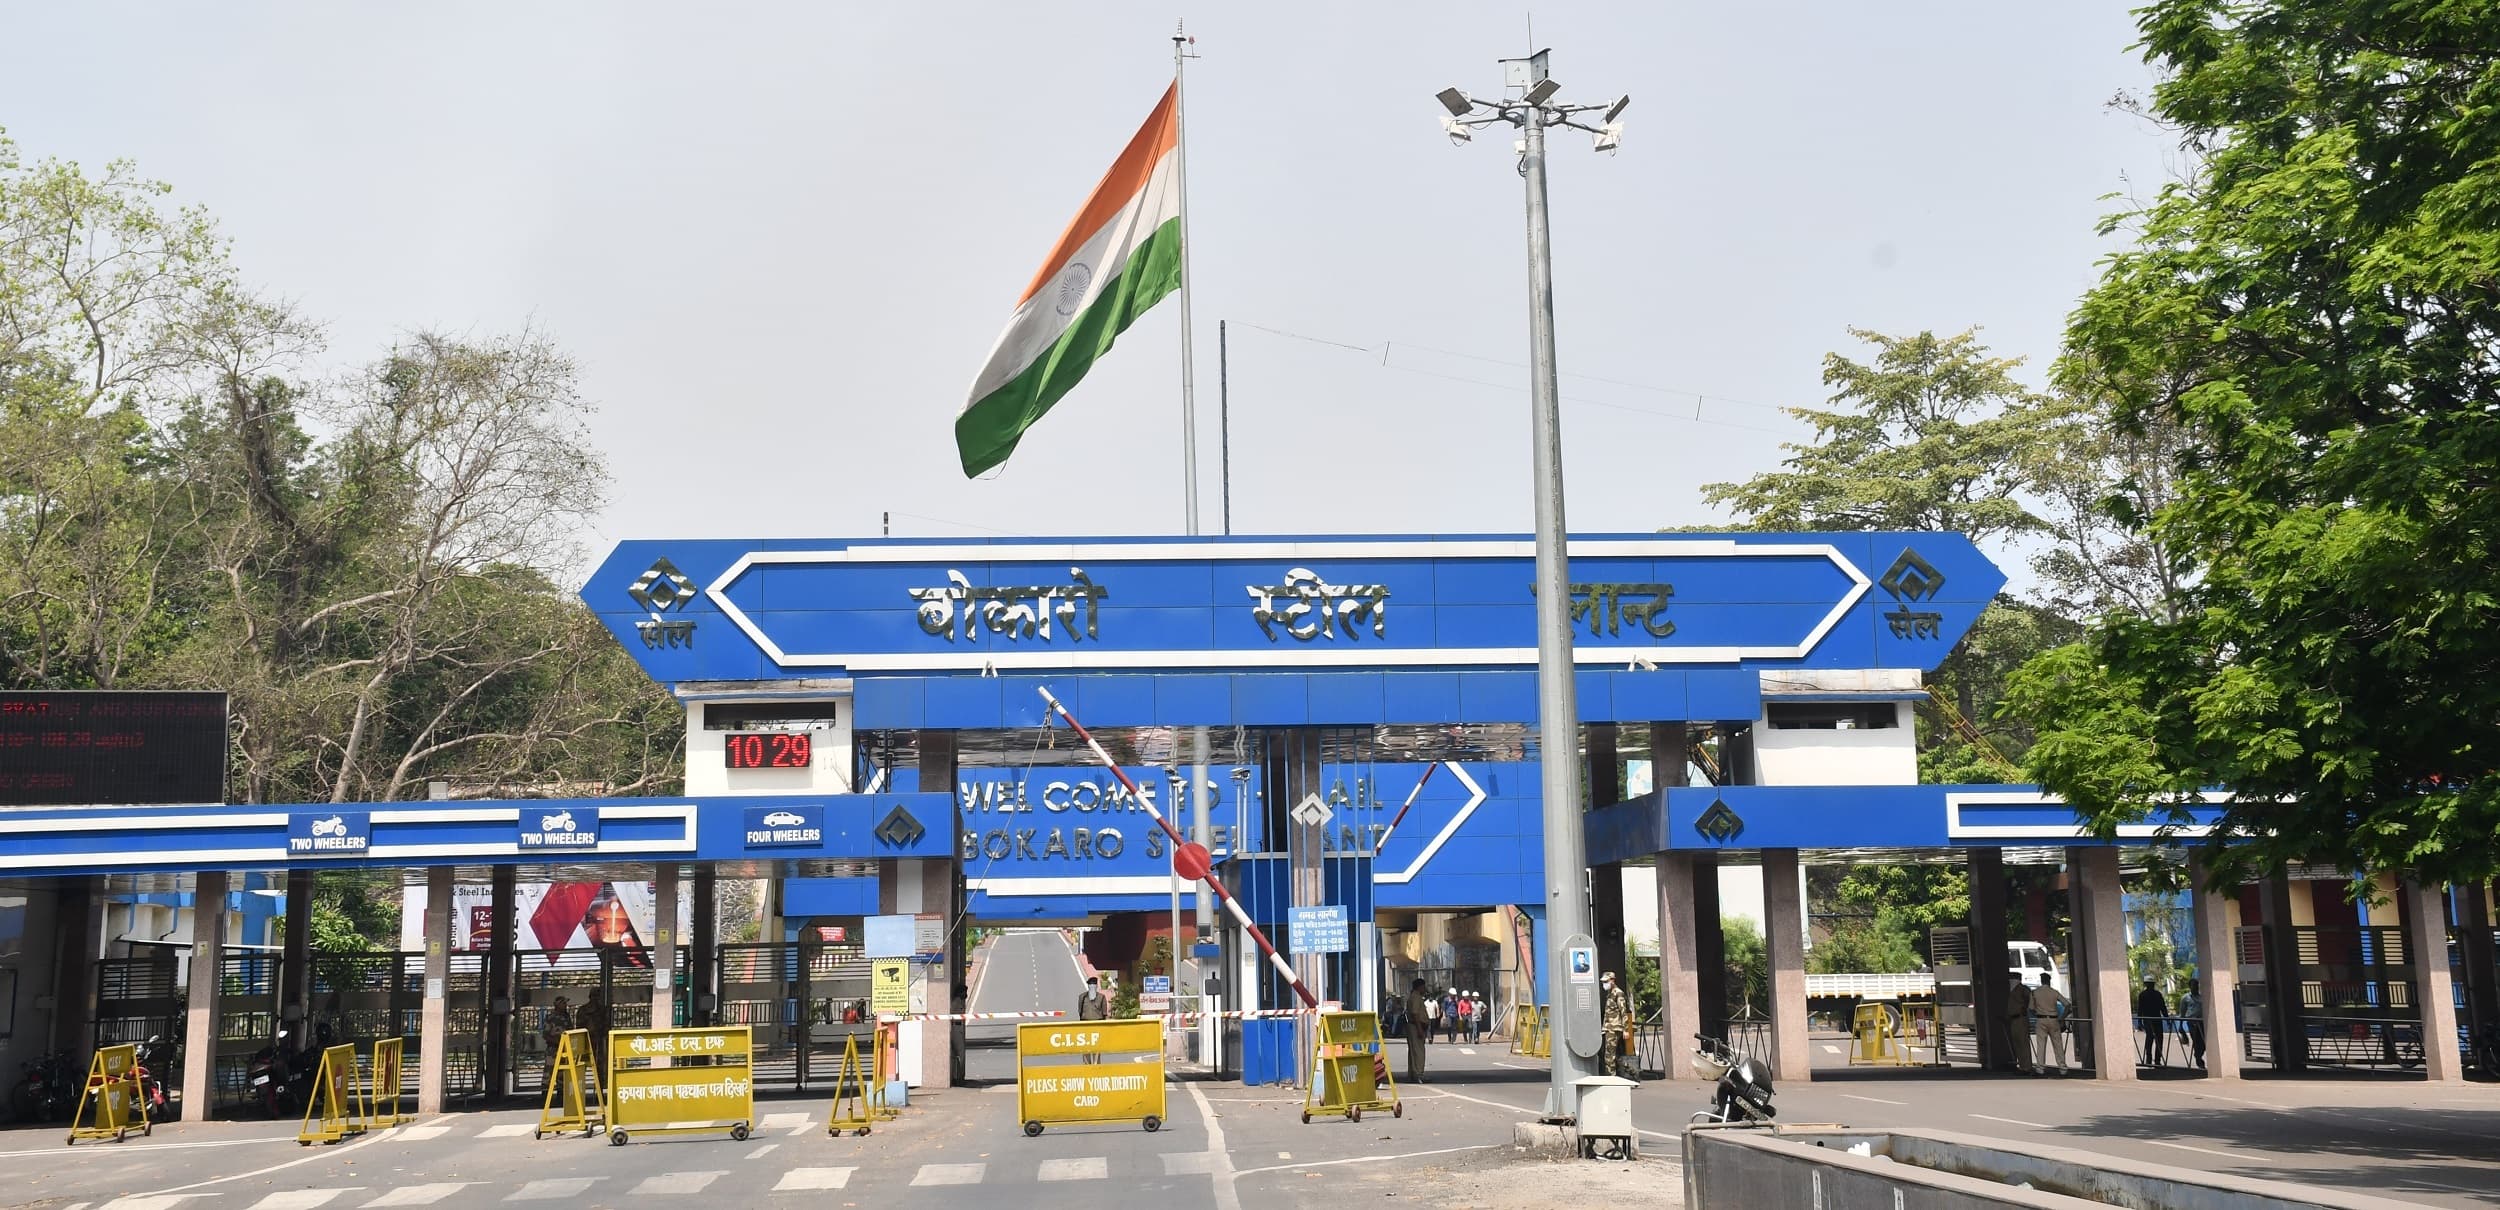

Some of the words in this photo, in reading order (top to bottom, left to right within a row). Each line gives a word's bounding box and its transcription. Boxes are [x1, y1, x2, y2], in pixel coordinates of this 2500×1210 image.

[908, 567, 1108, 642] बोकारो
[1246, 567, 1391, 642] स्टील
[1529, 583, 1676, 638] लान्ट
[634, 612, 698, 649] सेल
[1884, 602, 1943, 640] सेल
[290, 838, 312, 851] TWO
[314, 836, 366, 850] WHEELERS
[521, 832, 543, 846] TWO
[544, 832, 595, 845] WHEELERS
[747, 830, 772, 843] FOUR
[773, 829, 820, 842] WHEELERS
[962, 827, 1123, 859] BOKARO
[459, 887, 479, 896] Steel
[1342, 1064, 1358, 1083] STOP
[1027, 1078, 1058, 1094] PLEASE
[1061, 1077, 1086, 1092] SHOW
[1088, 1077, 1111, 1092] YOUR
[1111, 1075, 1148, 1091] IDENTITY
[1073, 1096, 1100, 1107] CARD
